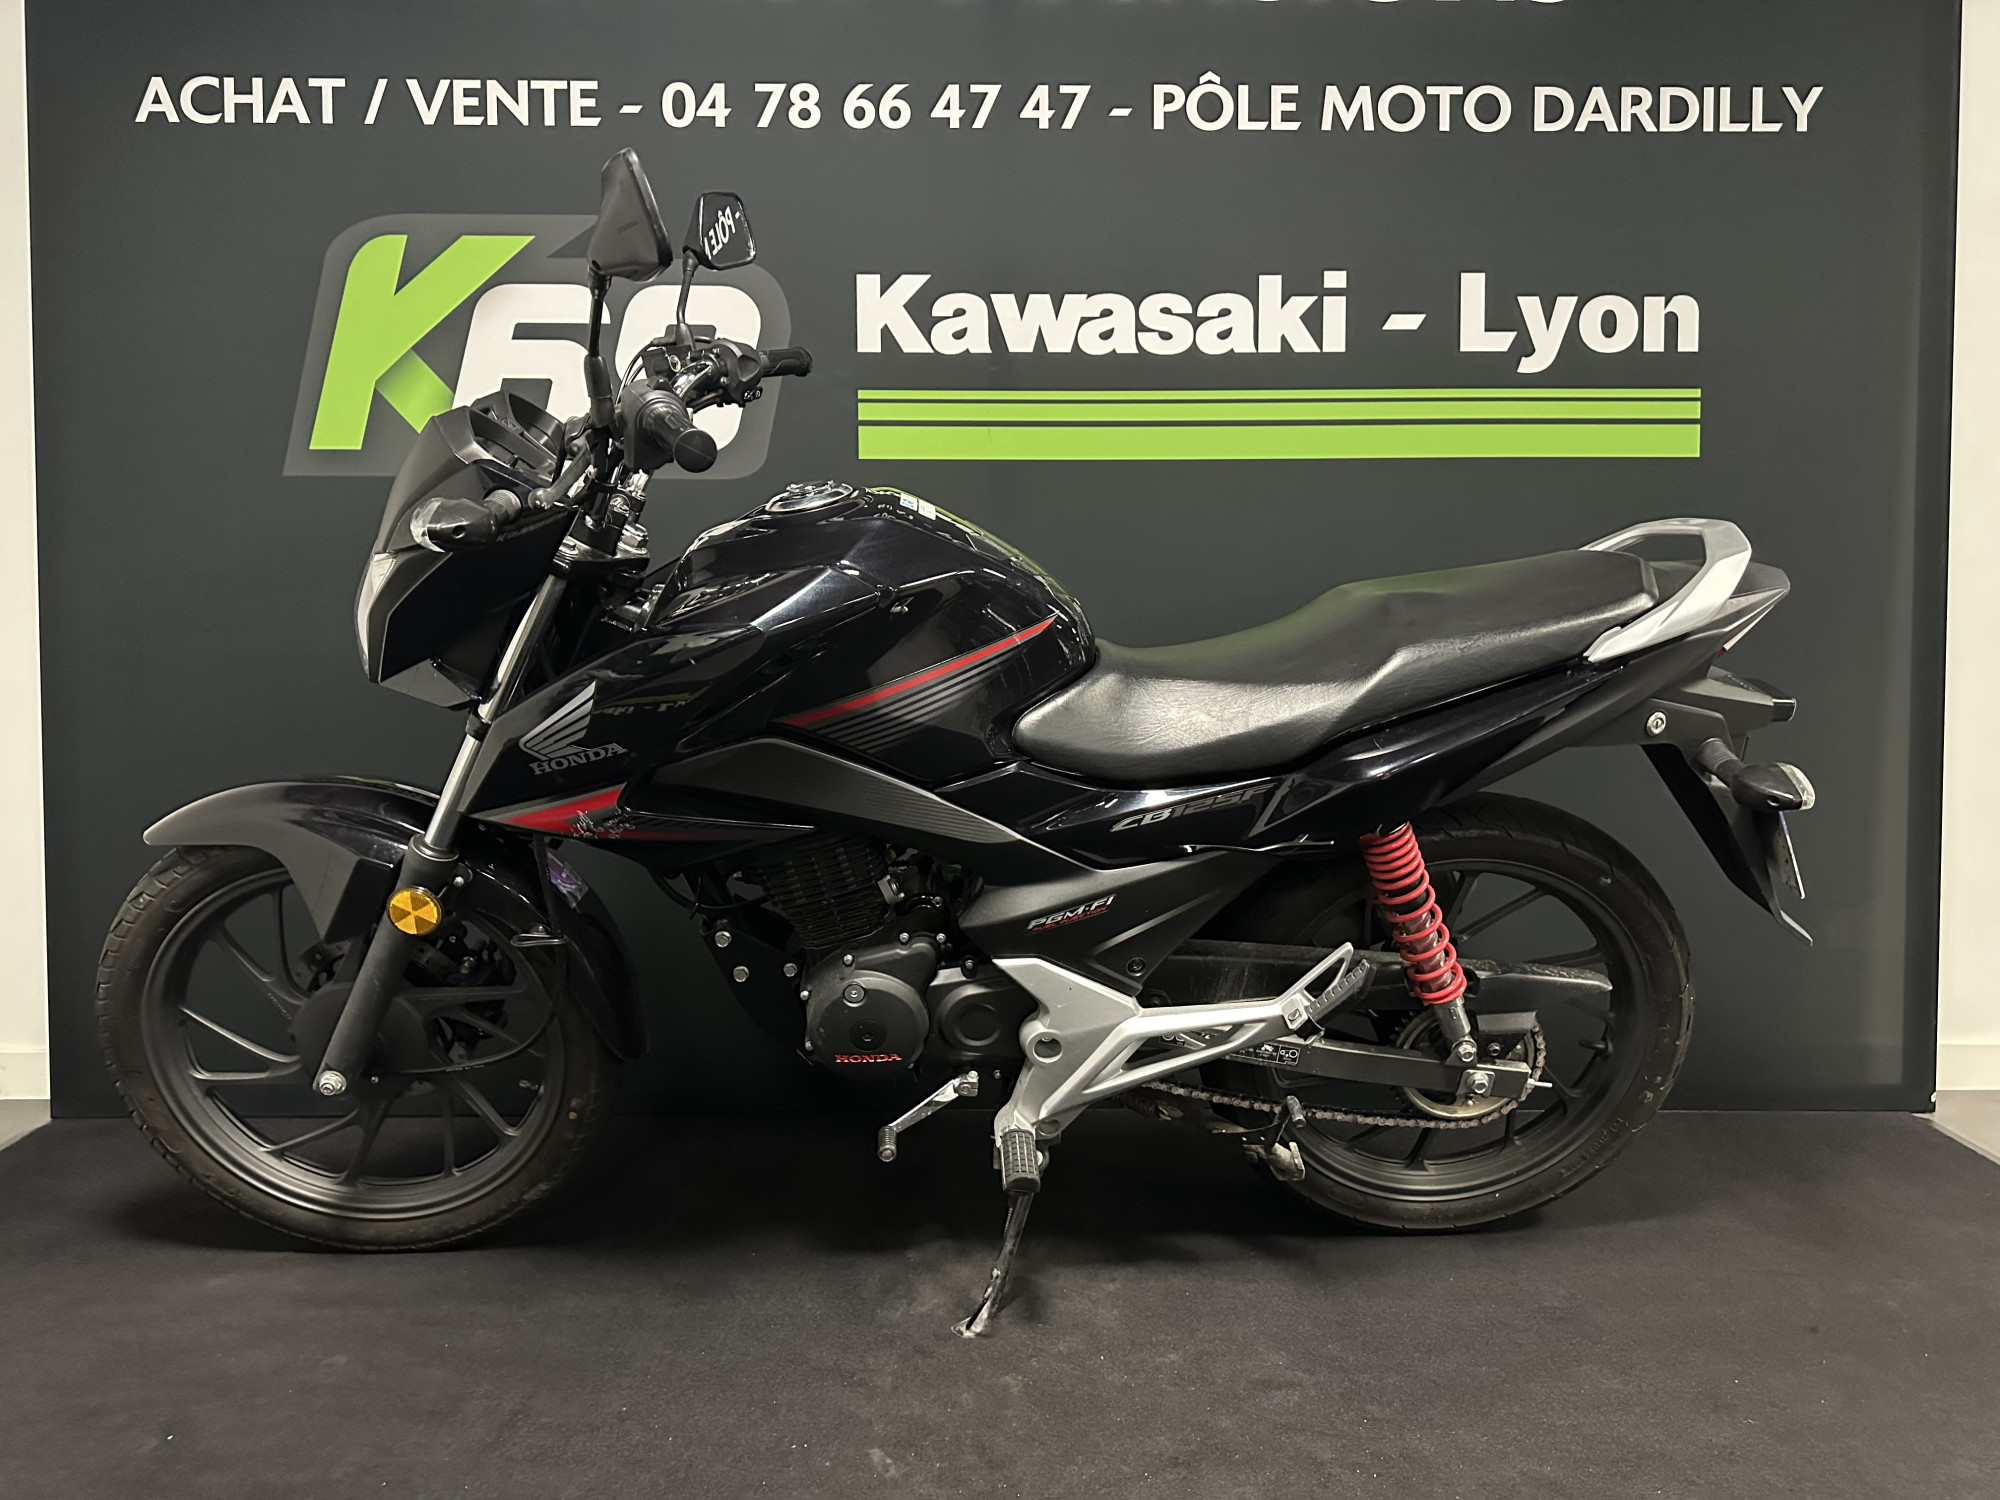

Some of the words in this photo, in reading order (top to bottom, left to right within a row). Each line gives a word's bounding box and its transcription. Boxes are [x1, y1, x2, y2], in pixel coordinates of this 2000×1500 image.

[134, 75, 346, 125] ACHAT
[364, 78, 389, 126] /
[405, 78, 602, 128] VENTE
[661, 81, 732, 129] 04
[754, 82, 822, 130] 78
[843, 82, 912, 131] 66
[930, 83, 1002, 130] 47
[1019, 83, 1092, 131] 47
[1152, 70, 1302, 132] PÔLE
[1320, 84, 1512, 133] MOTO
[1533, 85, 1824, 133] DARDILLY
[855, 270, 1347, 356] Kawasaki
[1459, 271, 1700, 374] Lyon
[529, 742, 628, 776] HONDA
[1110, 782, 1277, 832] CB125F
[834, 1053, 903, 1063] HONDA
